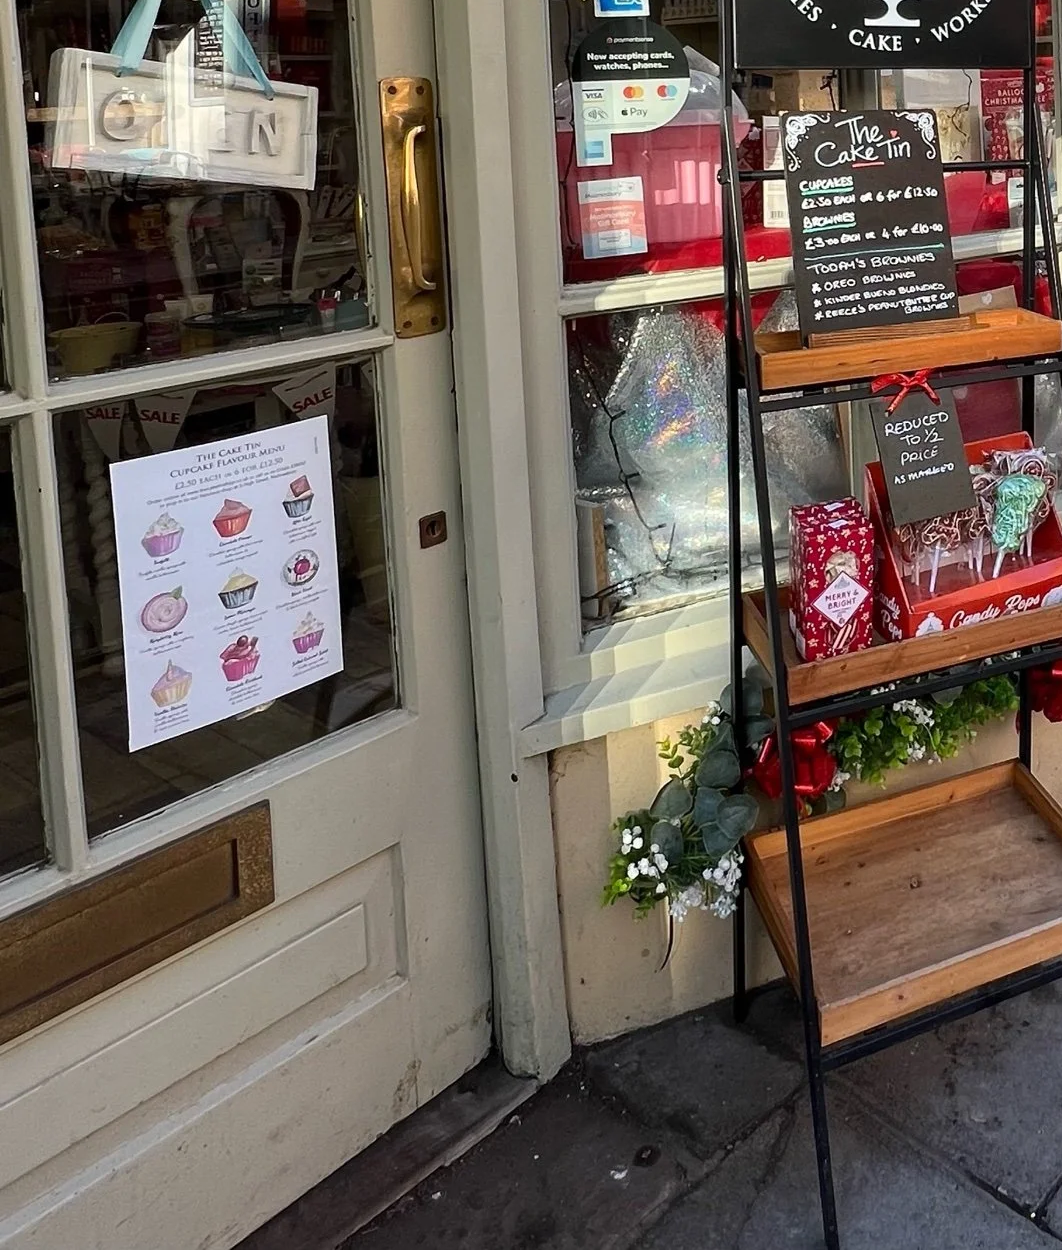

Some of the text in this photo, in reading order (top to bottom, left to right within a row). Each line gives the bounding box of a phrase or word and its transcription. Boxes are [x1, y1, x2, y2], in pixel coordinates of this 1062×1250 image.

[848, 28, 903, 52] CAKE
[587, 51, 675, 62] Now accepting cards,
[593, 61, 631, 71] watches,
[984, 96, 1025, 106] CHRISTMA
[630, 107, 648, 118] Pay
[101, 88, 280, 157] ON
[834, 115, 884, 145] The
[814, 136, 911, 168] Cake Tin
[799, 176, 854, 192] CUPCAKES
[834, 195, 856, 206] EACH
[860, 192, 873, 203] OR
[876, 191, 885, 203] 6
[886, 188, 902, 201] for
[803, 212, 856, 229] BROWNIES
[840, 233, 861, 244] EACH
[865, 231, 876, 240] OR
[881, 228, 891, 239] 4
[892, 226, 908, 237] for
[806, 253, 936, 275] TODAY'S BROWNIES
[824, 271, 917, 292] OREO BROWNIES
[824, 283, 946, 306] KINDER BUENO BLONDIES
[824, 305, 867, 319] REECE'S
[291, 386, 334, 414] SALE
[86, 406, 121, 420] SALE
[140, 408, 181, 425] SALE
[884, 411, 950, 437] REDUCED
[899, 434, 921, 445] TO
[169, 444, 286, 479] CUPCAKE FLAVOUR MENU
[196, 441, 262, 463] THE CAKE TIN
[900, 445, 939, 467] PRICE
[894, 462, 955, 485] AS MARKED
[825, 590, 852, 602] MERRY
[827, 597, 857, 610] BRIGHT
[950, 593, 1041, 629] Candy Pops
